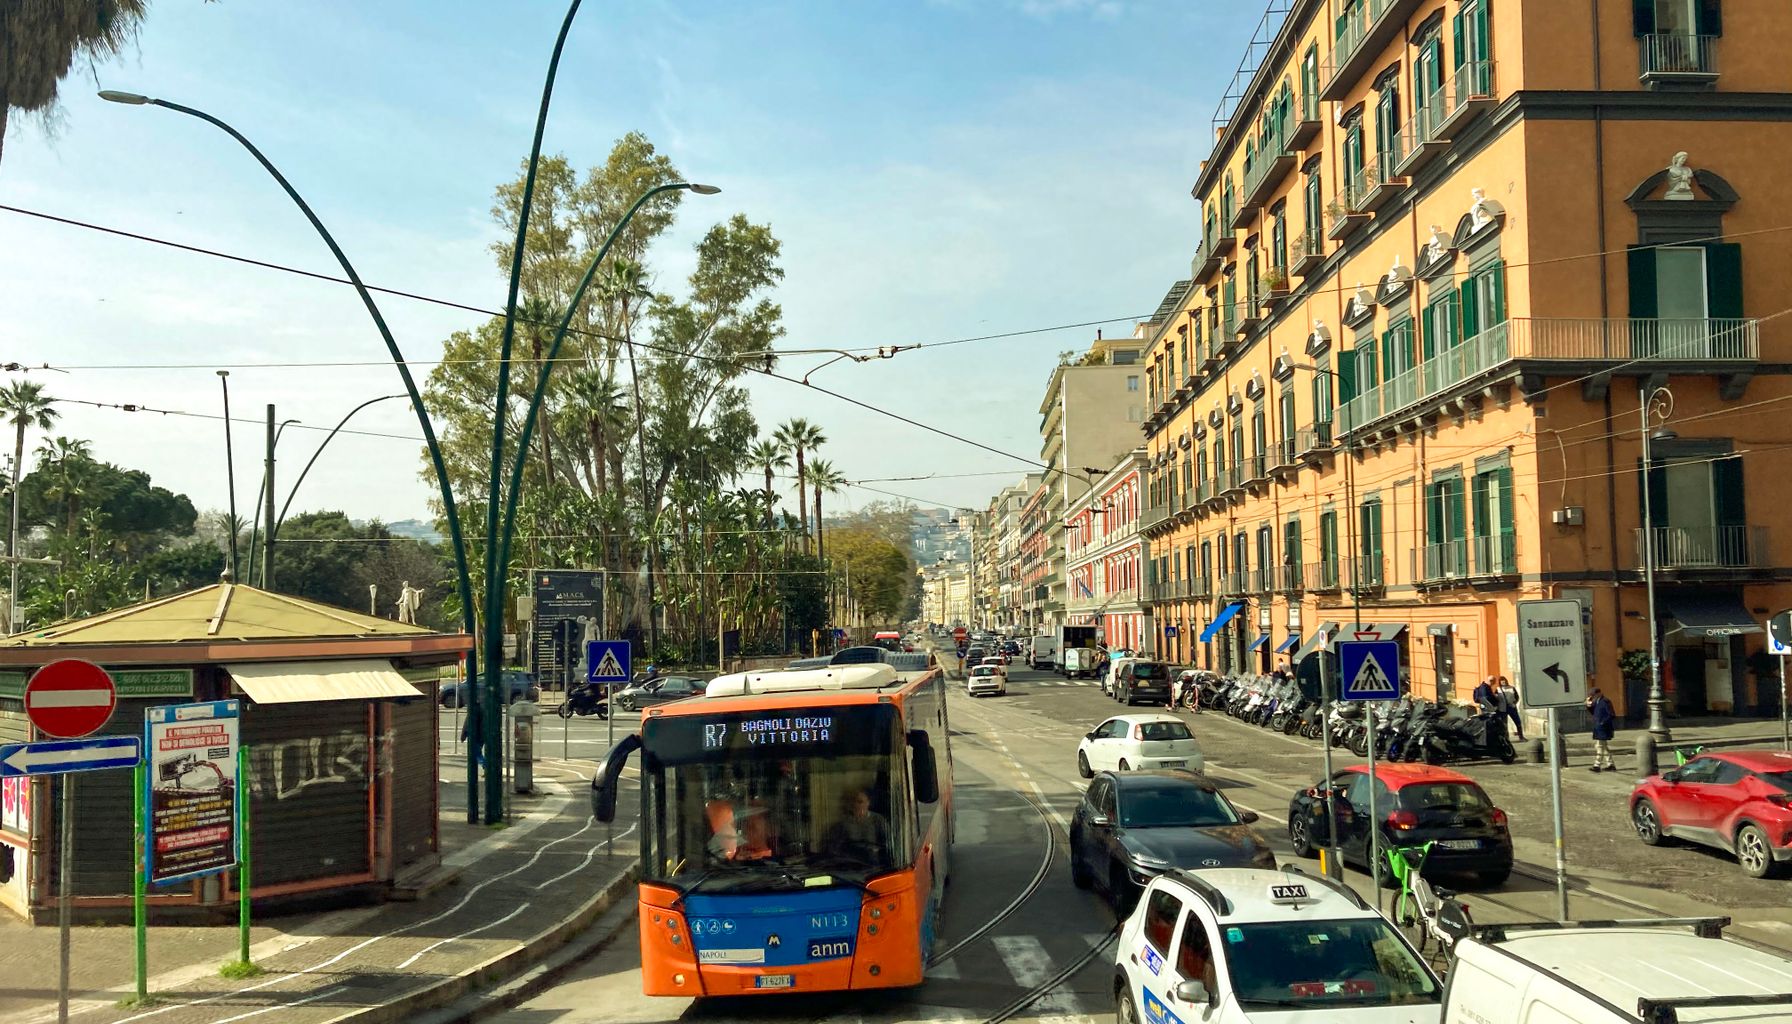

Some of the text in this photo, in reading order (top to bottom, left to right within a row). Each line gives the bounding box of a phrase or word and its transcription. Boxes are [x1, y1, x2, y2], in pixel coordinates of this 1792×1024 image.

[1534, 637, 1571, 648] Posillipo
[741, 718, 791, 732] BAGNOLI
[705, 723, 727, 747] R7
[748, 729, 829, 744] VITTORIA
[1273, 886, 1306, 897] TAXI
[811, 912, 848, 928] N113
[700, 951, 727, 960] NAPOLI
[811, 941, 849, 957] anm
